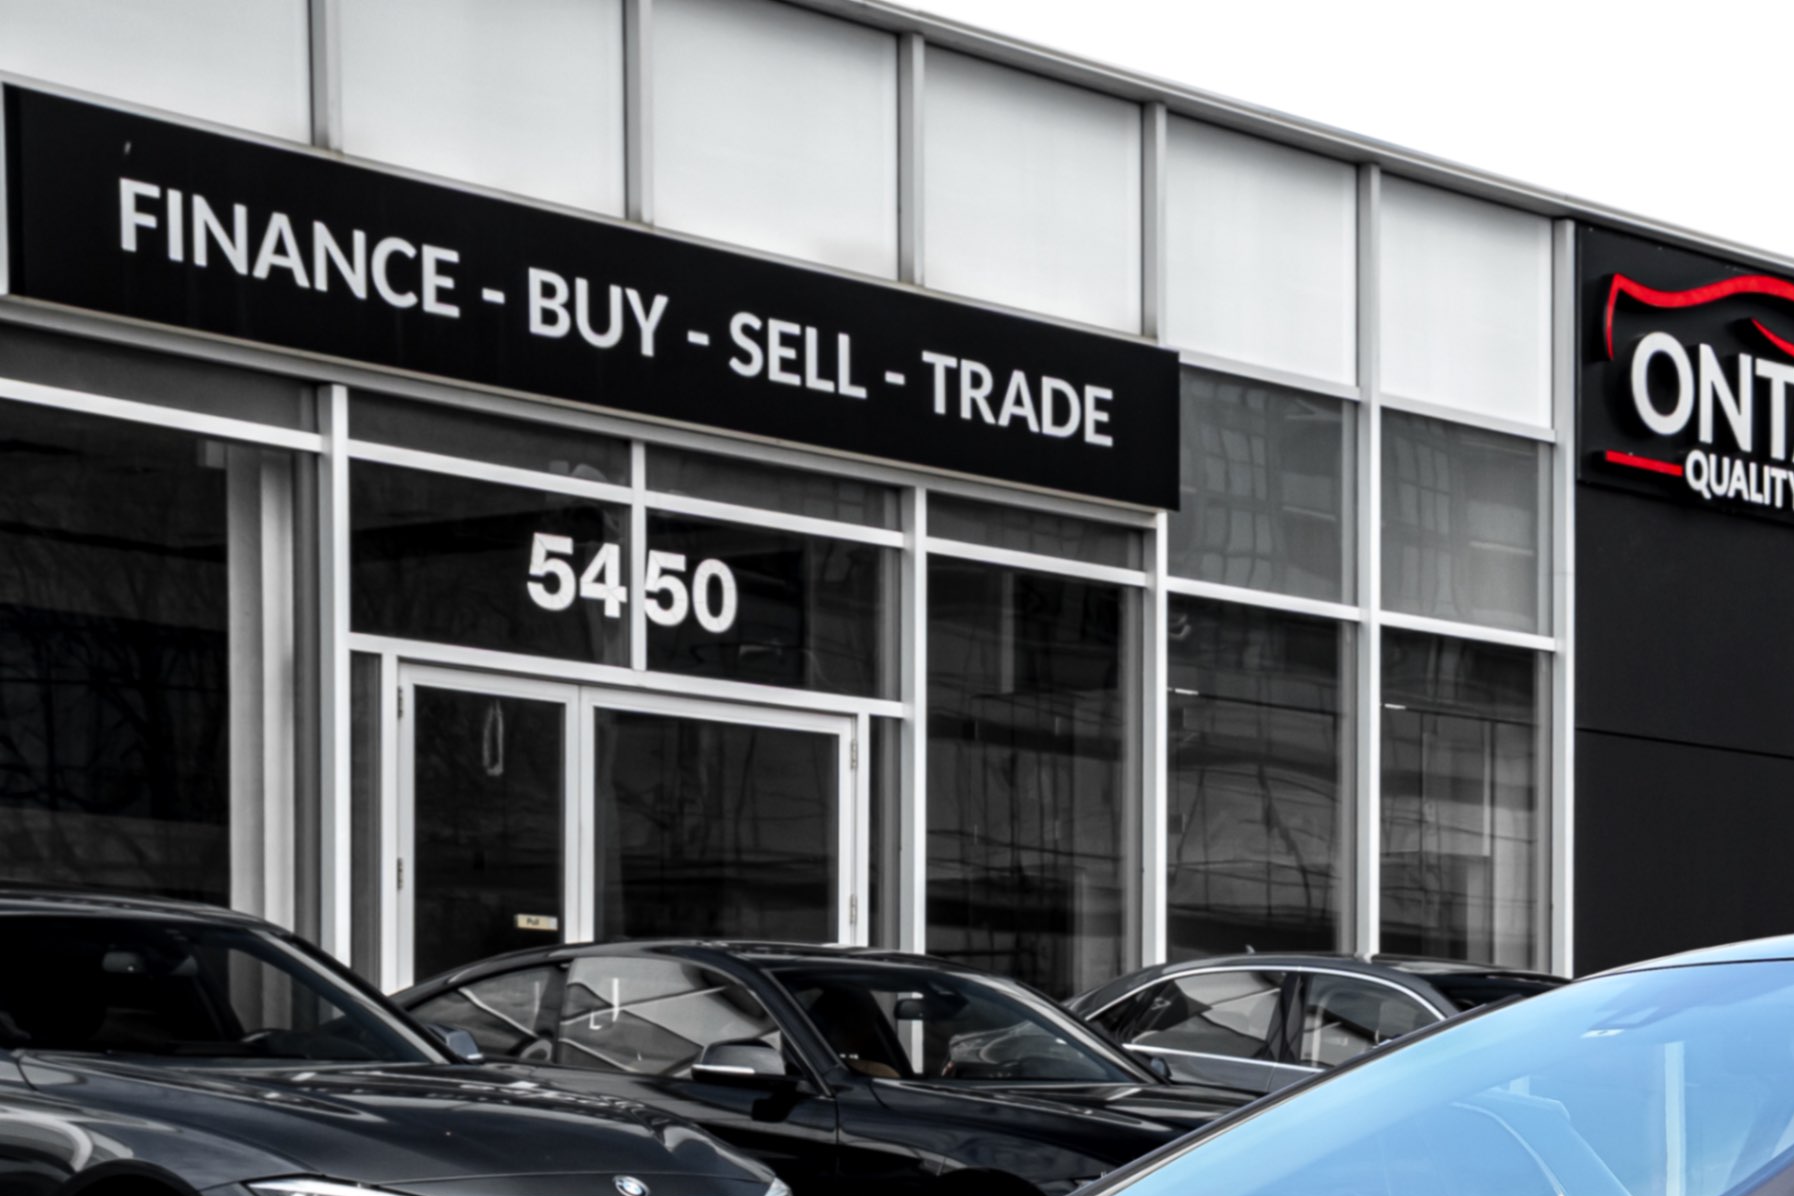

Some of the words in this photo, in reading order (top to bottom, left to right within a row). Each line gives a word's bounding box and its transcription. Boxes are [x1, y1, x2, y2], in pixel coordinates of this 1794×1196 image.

[118, 177, 461, 320] FINANCE
[528, 267, 669, 357] BUY
[729, 311, 867, 399] SELL
[921, 350, 1114, 447] TRADE
[526, 531, 738, 634] 5450
